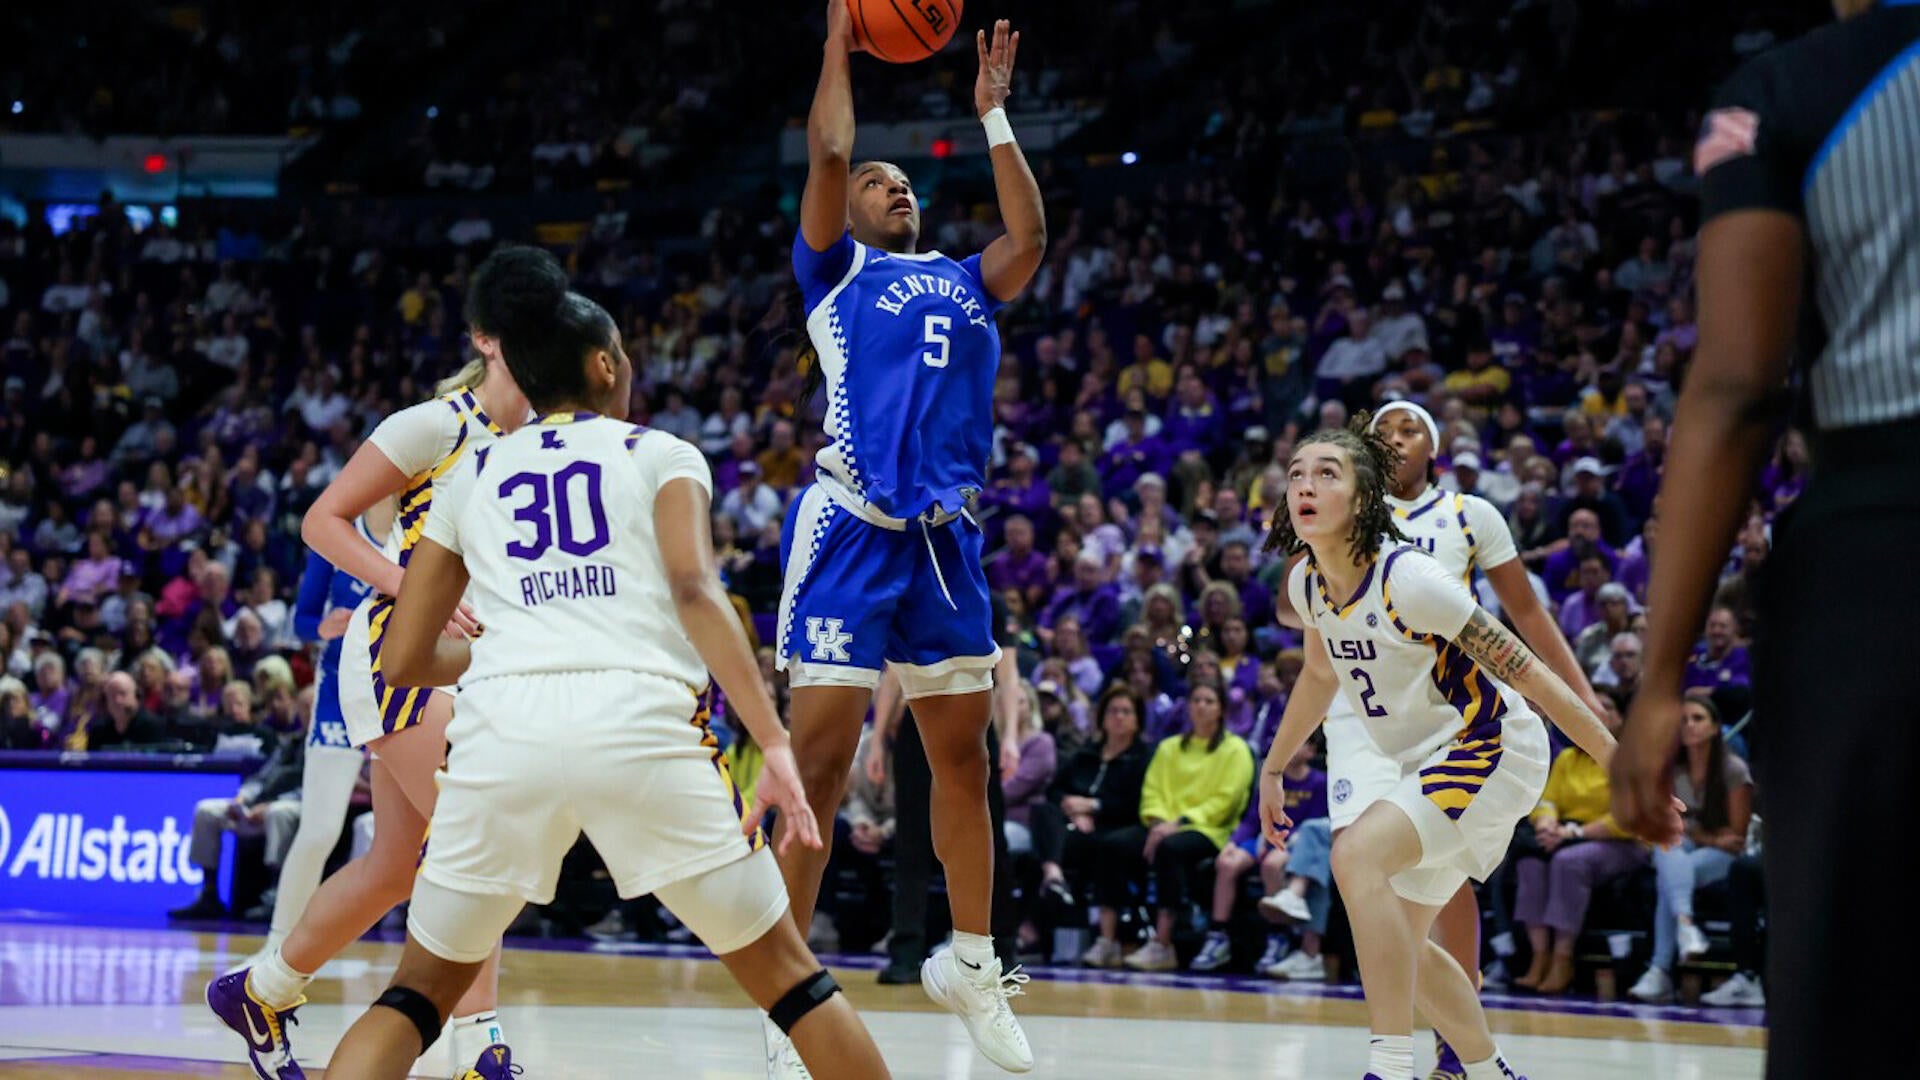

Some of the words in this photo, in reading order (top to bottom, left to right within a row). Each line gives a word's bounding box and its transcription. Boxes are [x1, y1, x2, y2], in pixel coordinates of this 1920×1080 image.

[875, 273, 989, 329] KENTUCKY
[923, 314, 952, 369] 5
[498, 460, 610, 562] 30
[520, 565, 616, 606] RICHARD
[805, 616, 853, 662] UK
[1327, 637, 1377, 661] LSU
[1350, 667, 1388, 717] 2
